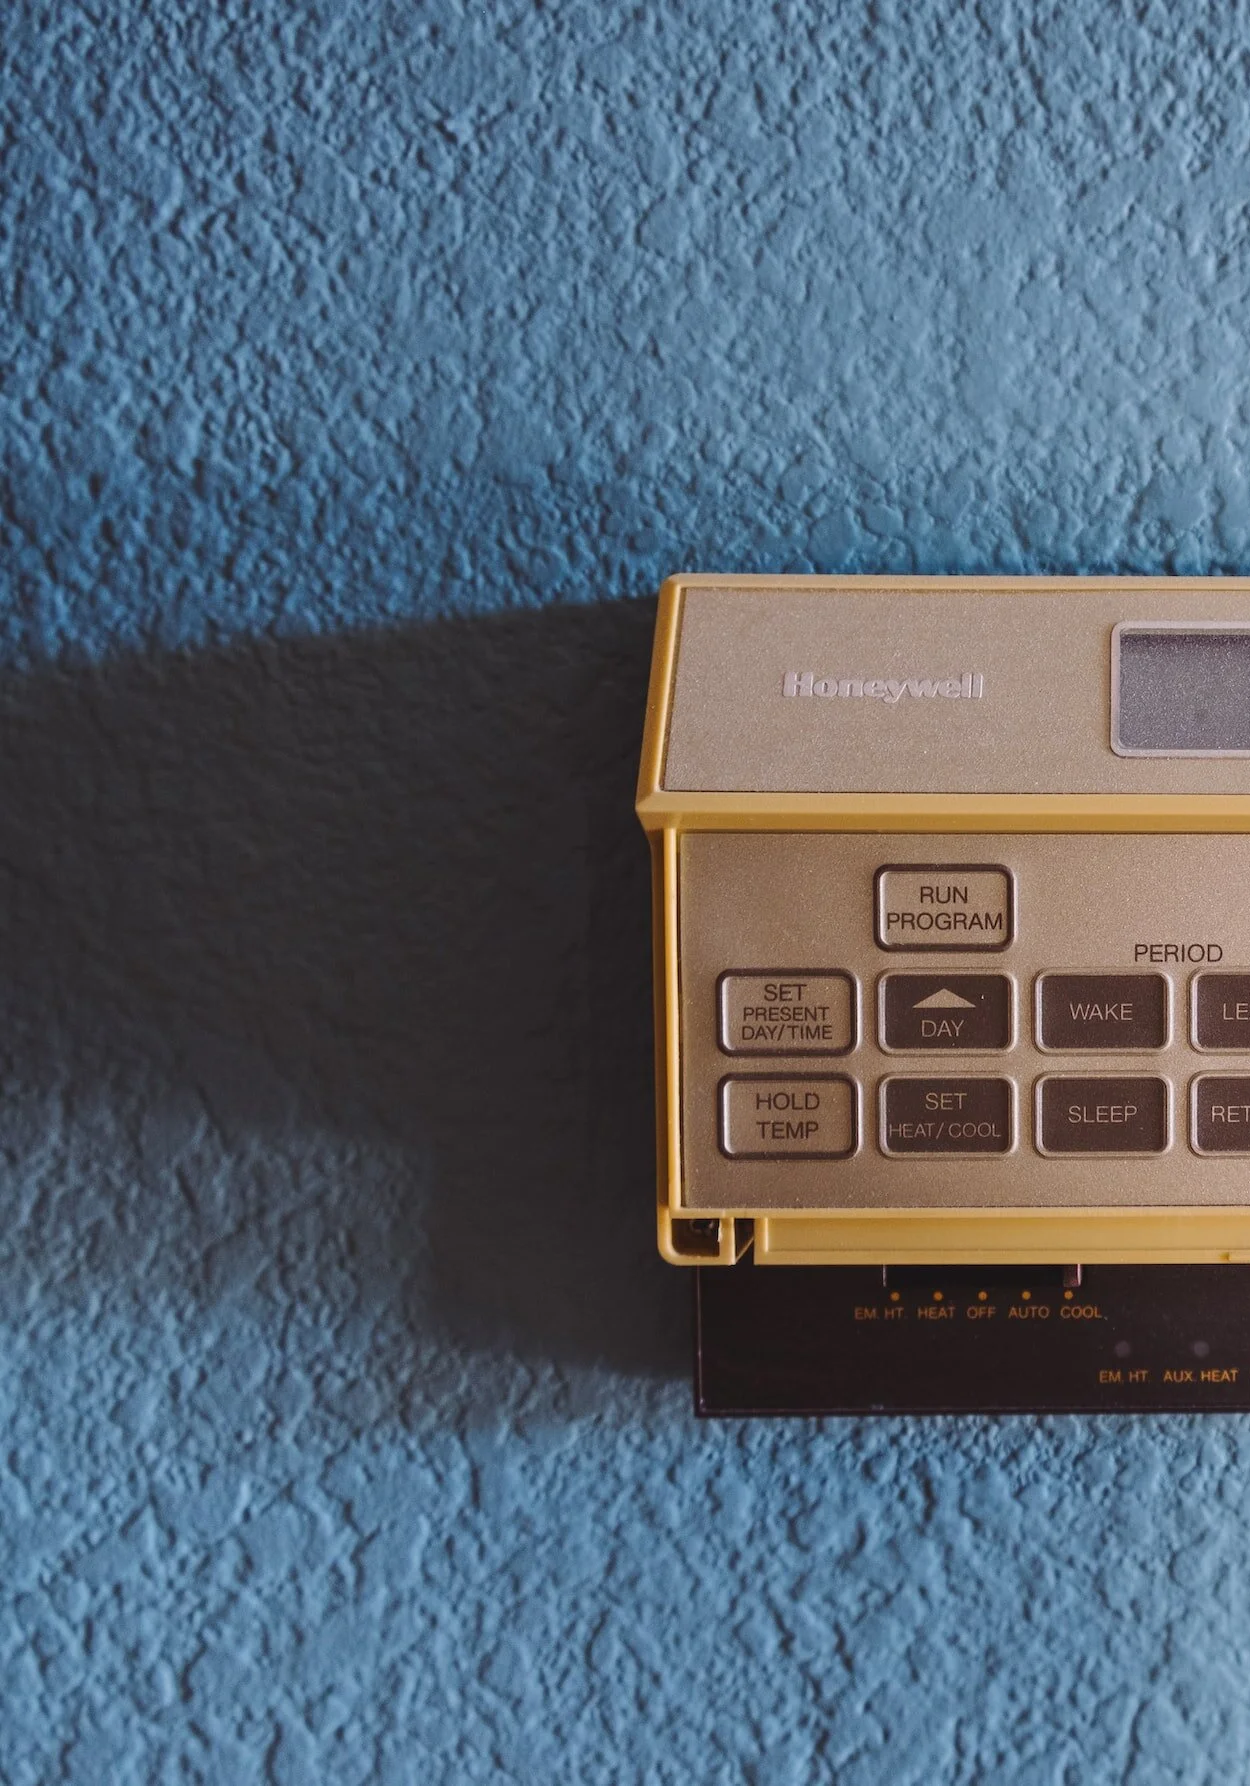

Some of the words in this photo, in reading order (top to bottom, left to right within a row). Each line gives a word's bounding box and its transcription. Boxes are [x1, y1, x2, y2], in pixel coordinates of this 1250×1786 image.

[783, 671, 983, 703] Honeywell
[920, 886, 968, 904] RUN
[887, 913, 1003, 930] PROGRAM
[1134, 944, 1223, 962] PERIOD
[764, 984, 807, 1001] SET
[743, 1007, 830, 1022] PRESENT
[1070, 1004, 1134, 1020] WAKE
[741, 1025, 833, 1041] DAY/TIME
[921, 1020, 964, 1037] DAY
[756, 1092, 820, 1110] HOLD
[925, 1093, 967, 1110] SET
[1068, 1106, 1138, 1123] SLEEP
[757, 1122, 819, 1139] TEMP
[918, 1307, 955, 1319] HEAT
[967, 1306, 996, 1319] OFF
[1008, 1306, 1050, 1319] AUTO
[1060, 1306, 1103, 1319] COOL
[1201, 1369, 1238, 1382] HEAT
